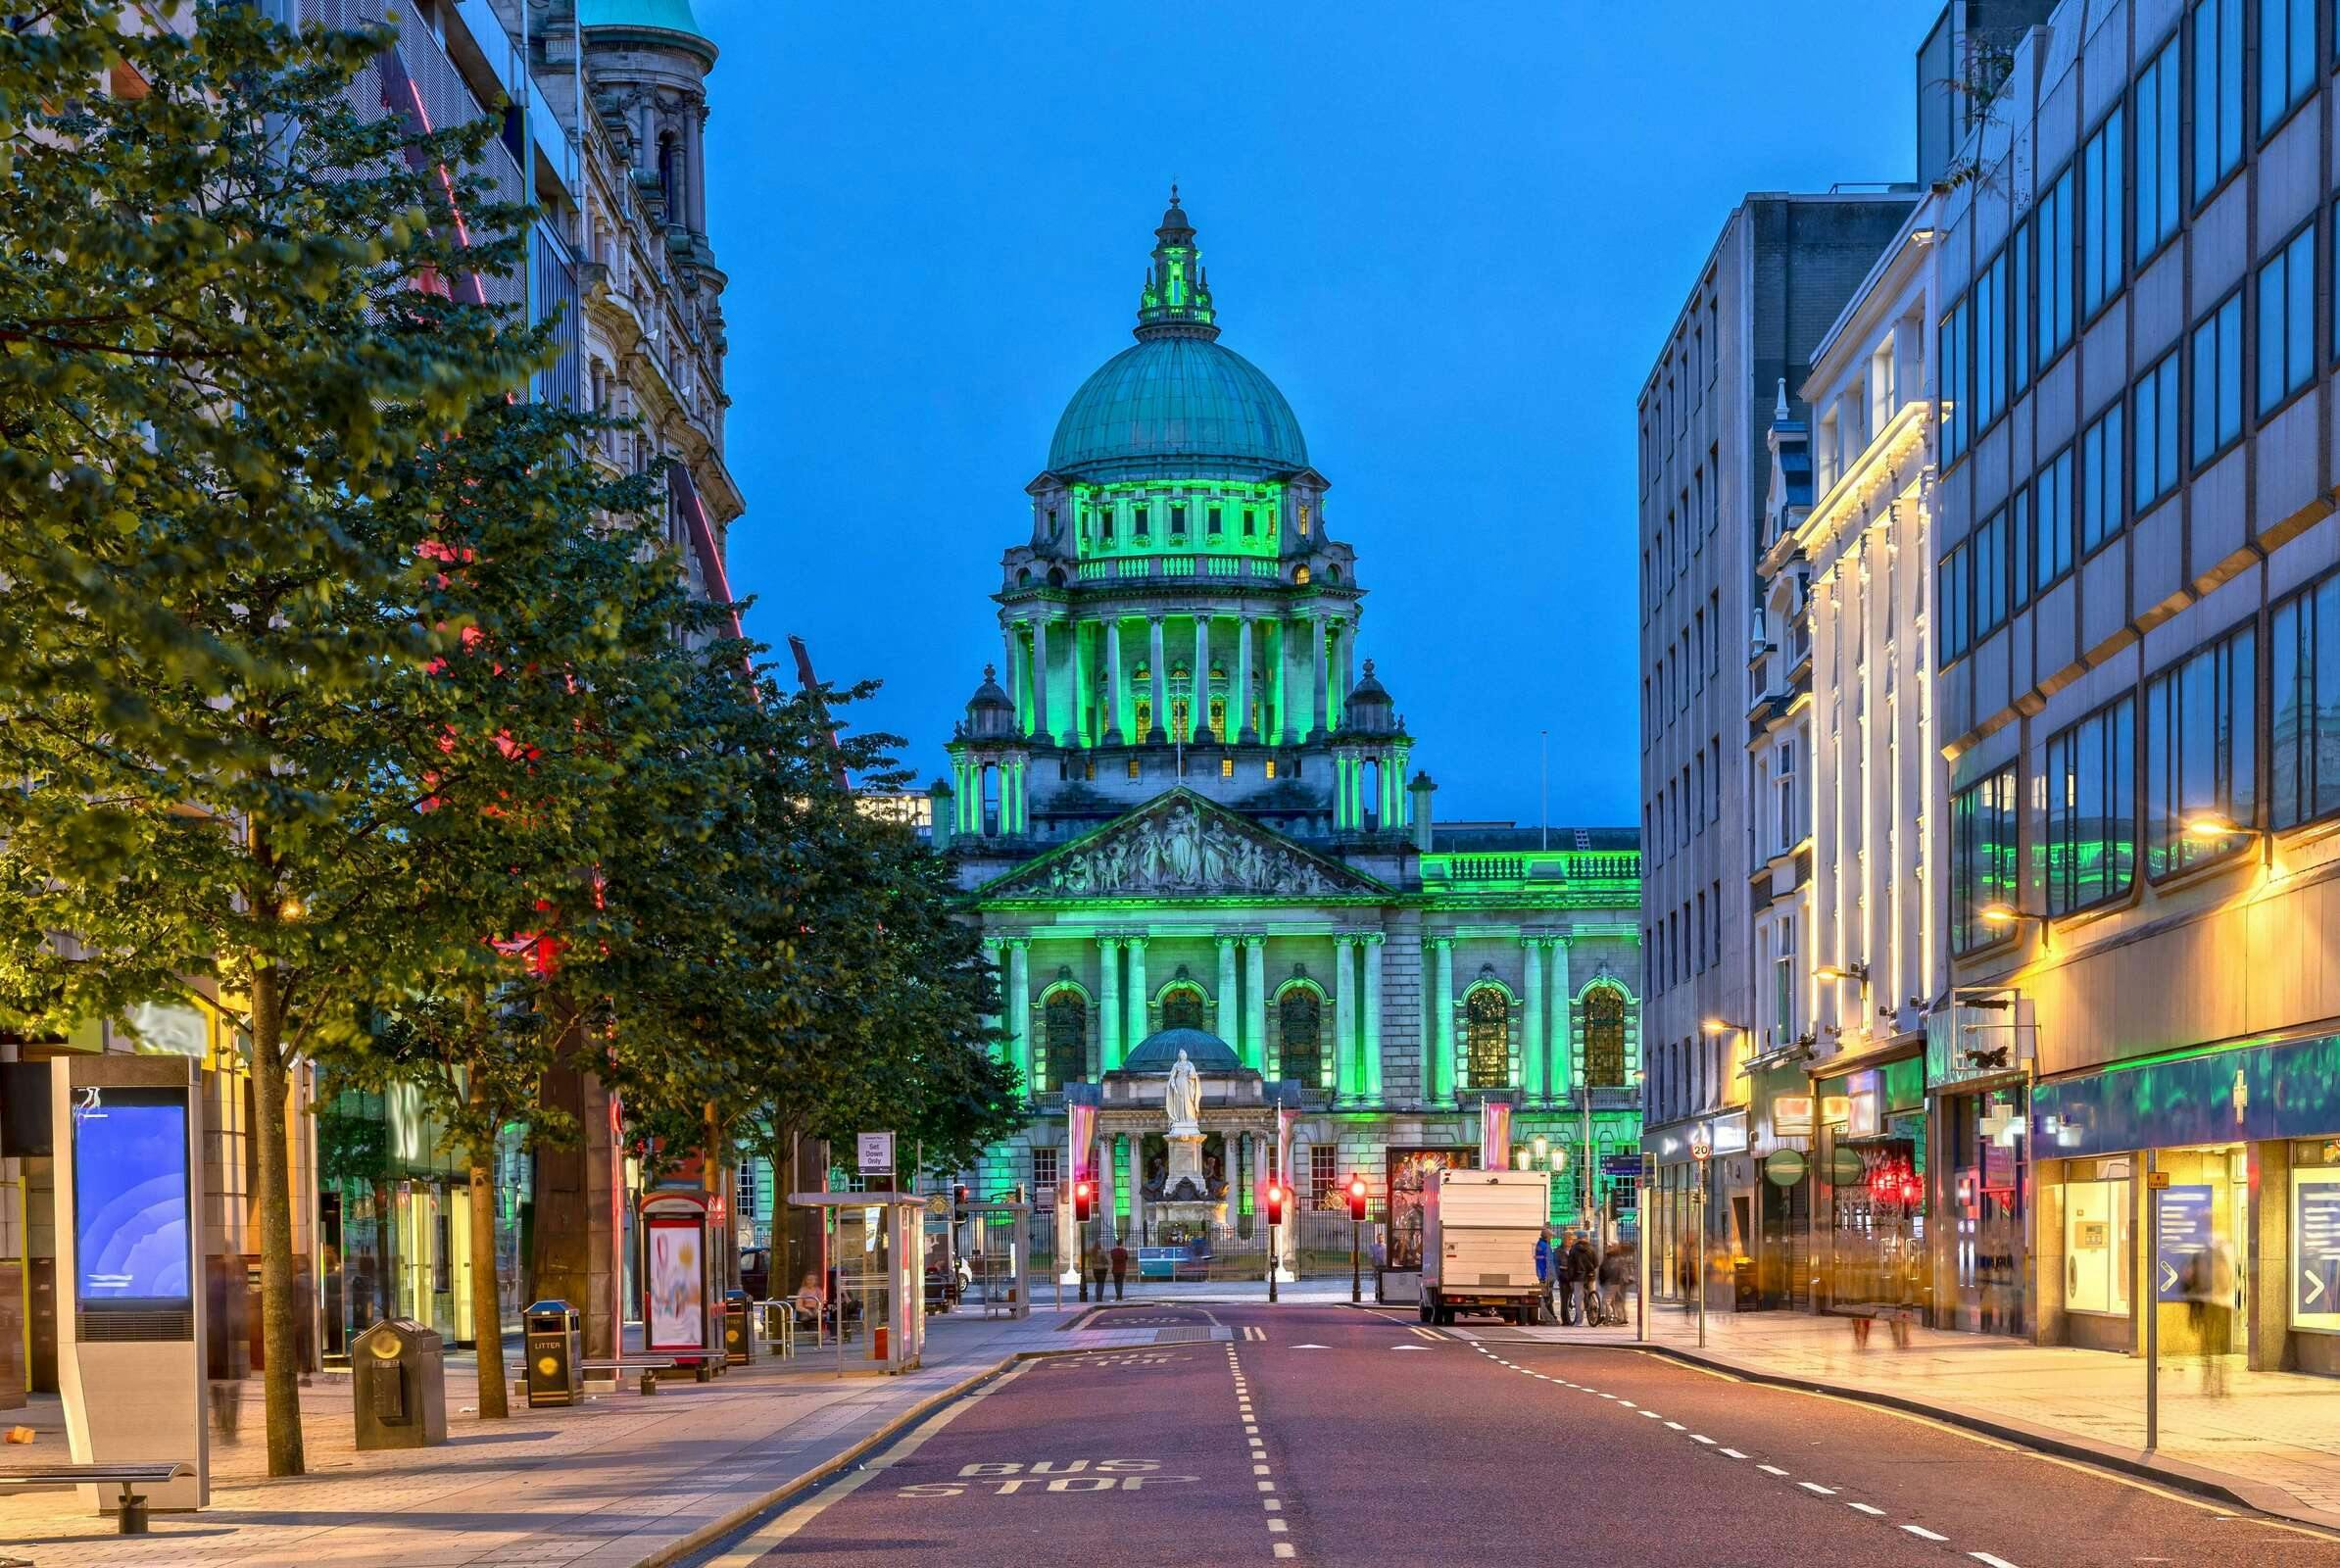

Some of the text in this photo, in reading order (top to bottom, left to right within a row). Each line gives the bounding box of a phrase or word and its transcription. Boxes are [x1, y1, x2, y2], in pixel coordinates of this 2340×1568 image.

[1694, 1146, 1708, 1154] 20
[957, 1459, 1160, 1477] BUS
[898, 1476, 1200, 1497] STOP
